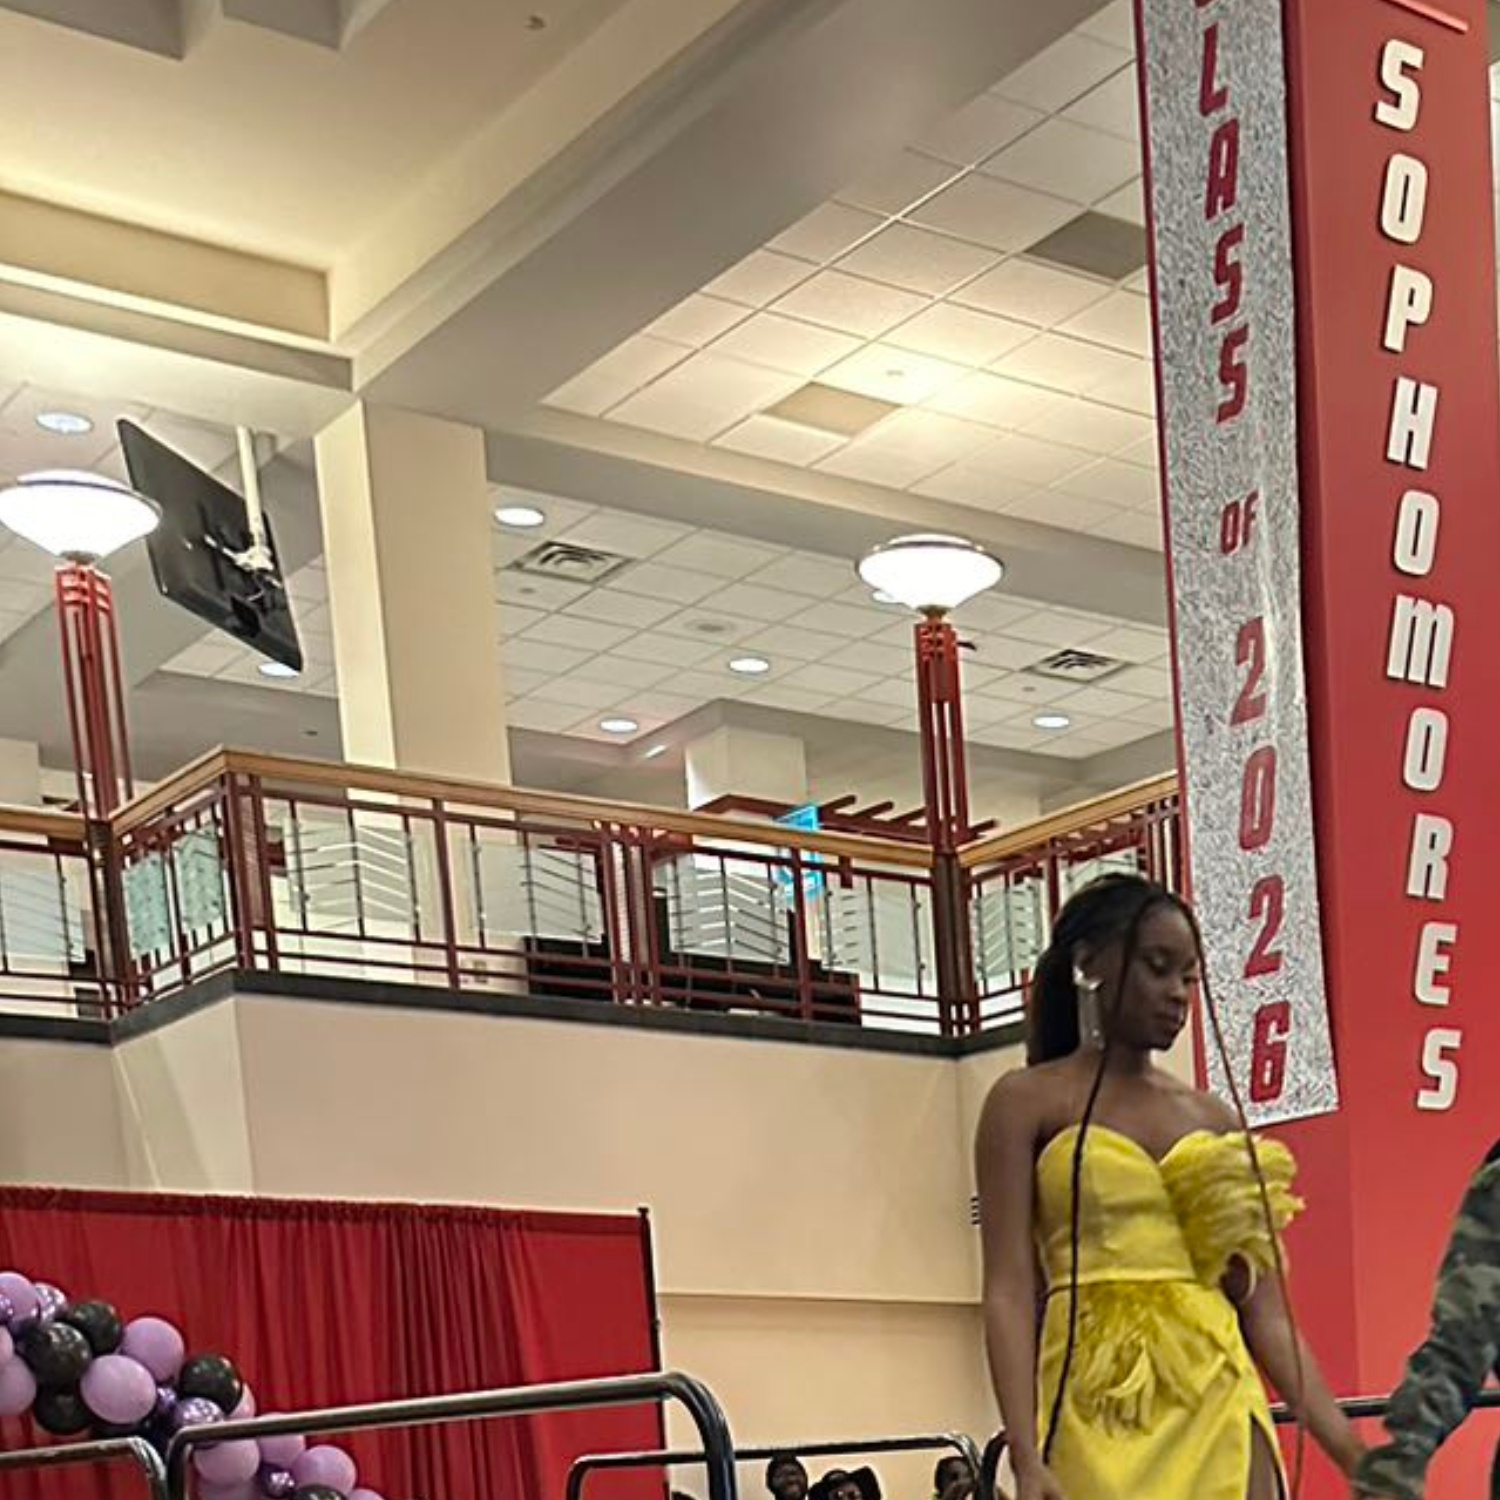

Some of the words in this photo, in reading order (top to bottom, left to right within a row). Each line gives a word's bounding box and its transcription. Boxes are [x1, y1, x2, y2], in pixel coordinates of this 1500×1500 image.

[1194, 0, 1249, 424] LASS
[1219, 490, 1259, 554] OF
[1374, 38, 1462, 1111] SOPHOMORES
[1229, 615, 1291, 1103] 2026
